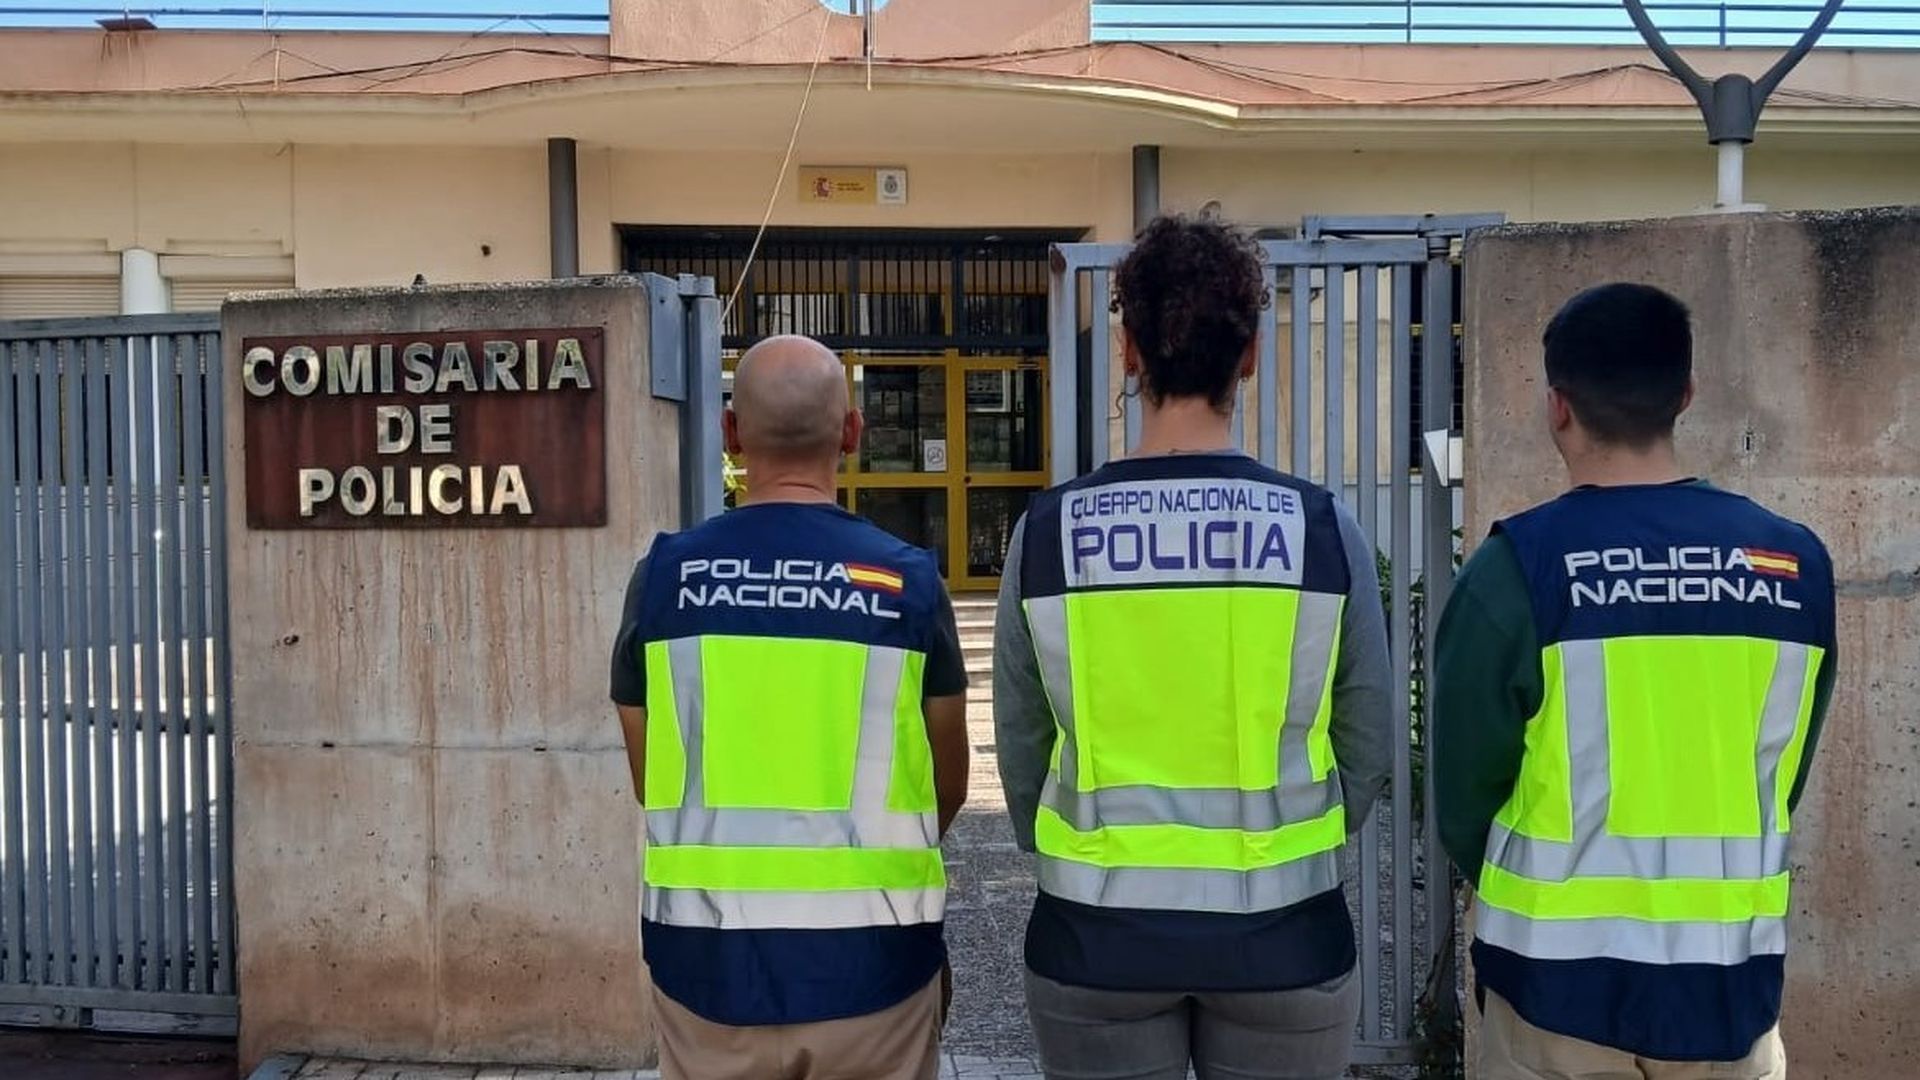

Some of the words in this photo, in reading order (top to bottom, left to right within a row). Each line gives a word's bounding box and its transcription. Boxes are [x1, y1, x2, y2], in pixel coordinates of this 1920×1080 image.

[243, 338, 592, 397] COMISARIA
[376, 404, 453, 454] DE
[299, 464, 533, 517] POLICIA
[1071, 490, 1153, 519] CUERPO
[1159, 487, 1262, 513] NACIONAL
[1266, 491, 1295, 514] DE
[1071, 521, 1292, 574] POLICIA
[678, 584, 901, 619] NACIONAL
[1570, 577, 1801, 610] NACIONAL
